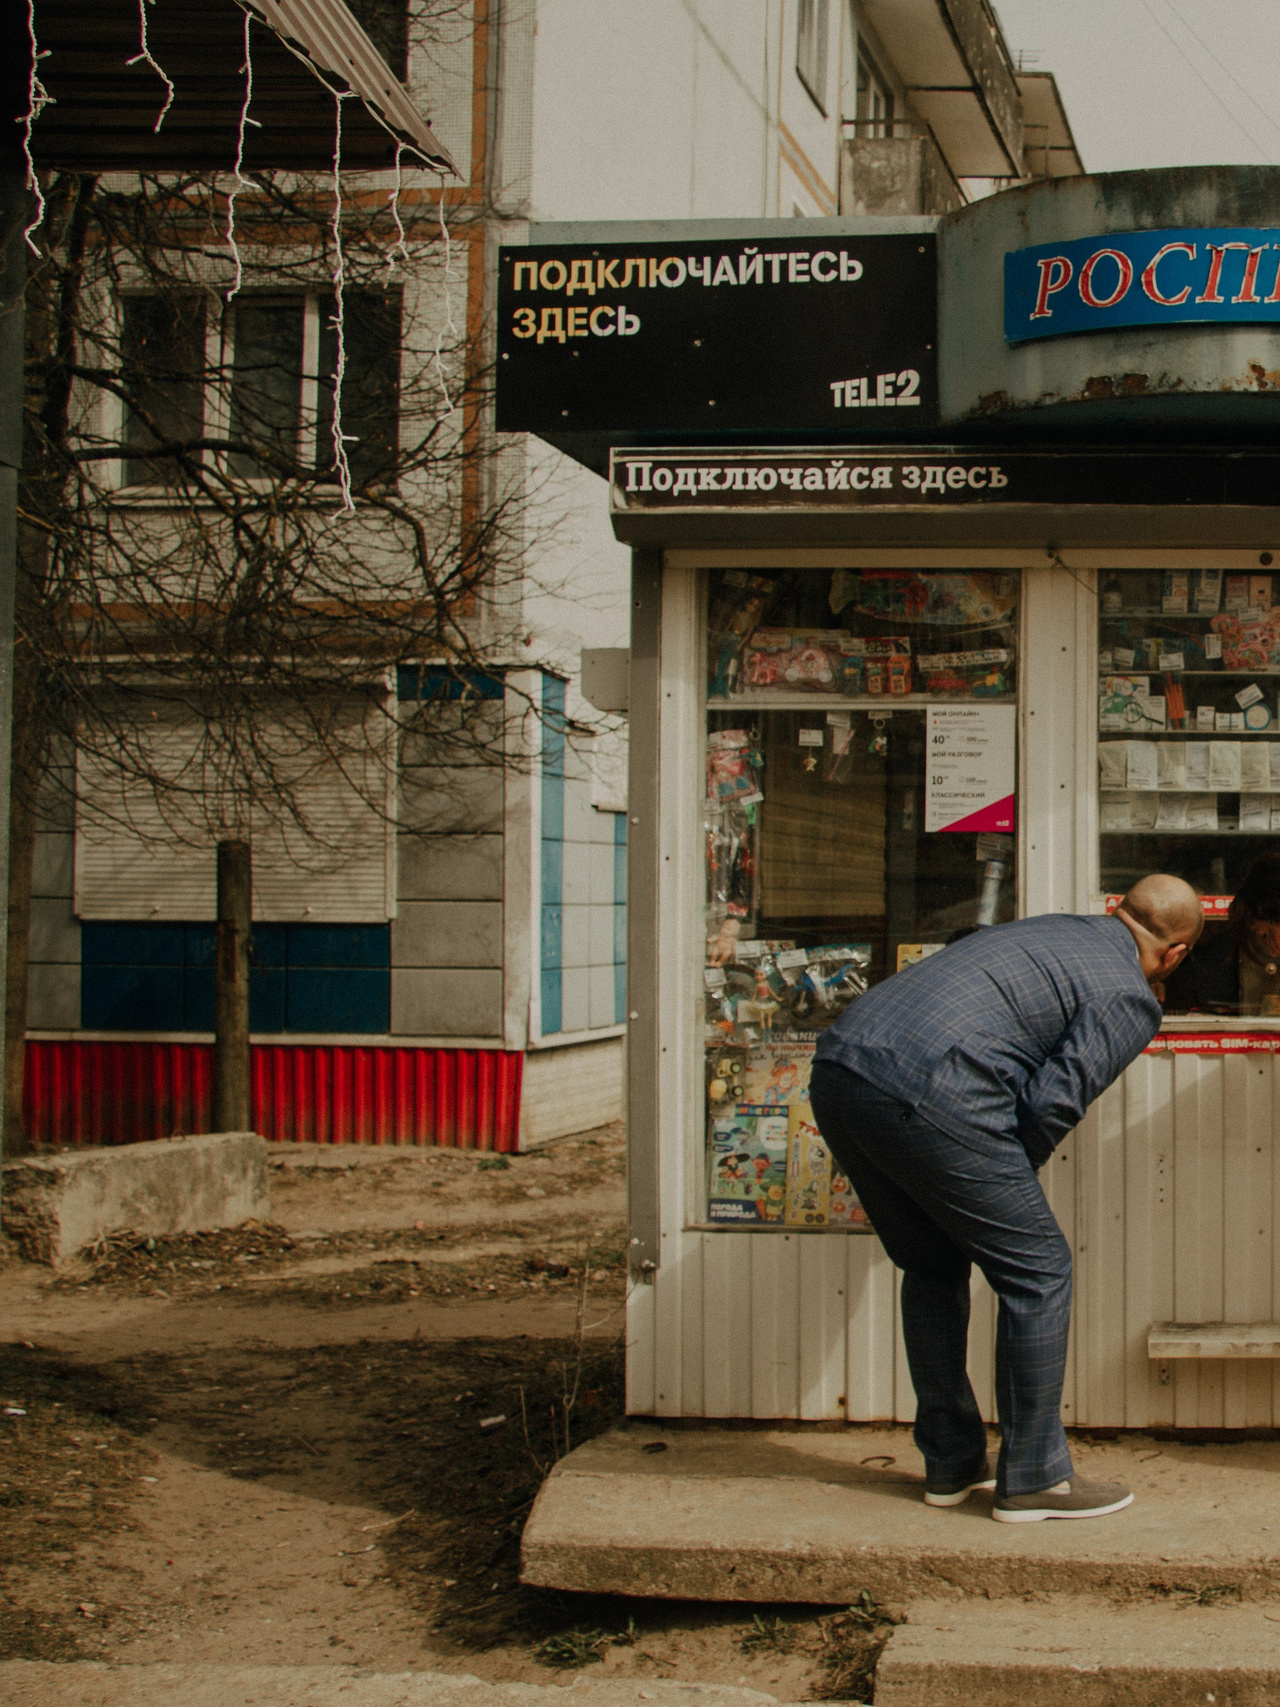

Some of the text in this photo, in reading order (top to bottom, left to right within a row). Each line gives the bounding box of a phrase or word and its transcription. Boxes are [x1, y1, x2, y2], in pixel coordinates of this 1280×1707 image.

[513, 247, 864, 296] ПОДКЛЮЧАЙТЕСЬ
[512, 305, 641, 344] ЗДЕСЬ
[829, 369, 921, 408] TELE2
[625, 460, 1008, 496] Подключайся здесь
[932, 735, 945, 744] 40
[932, 776, 943, 785] 10
[1148, 1040, 1219, 1050] вировать
